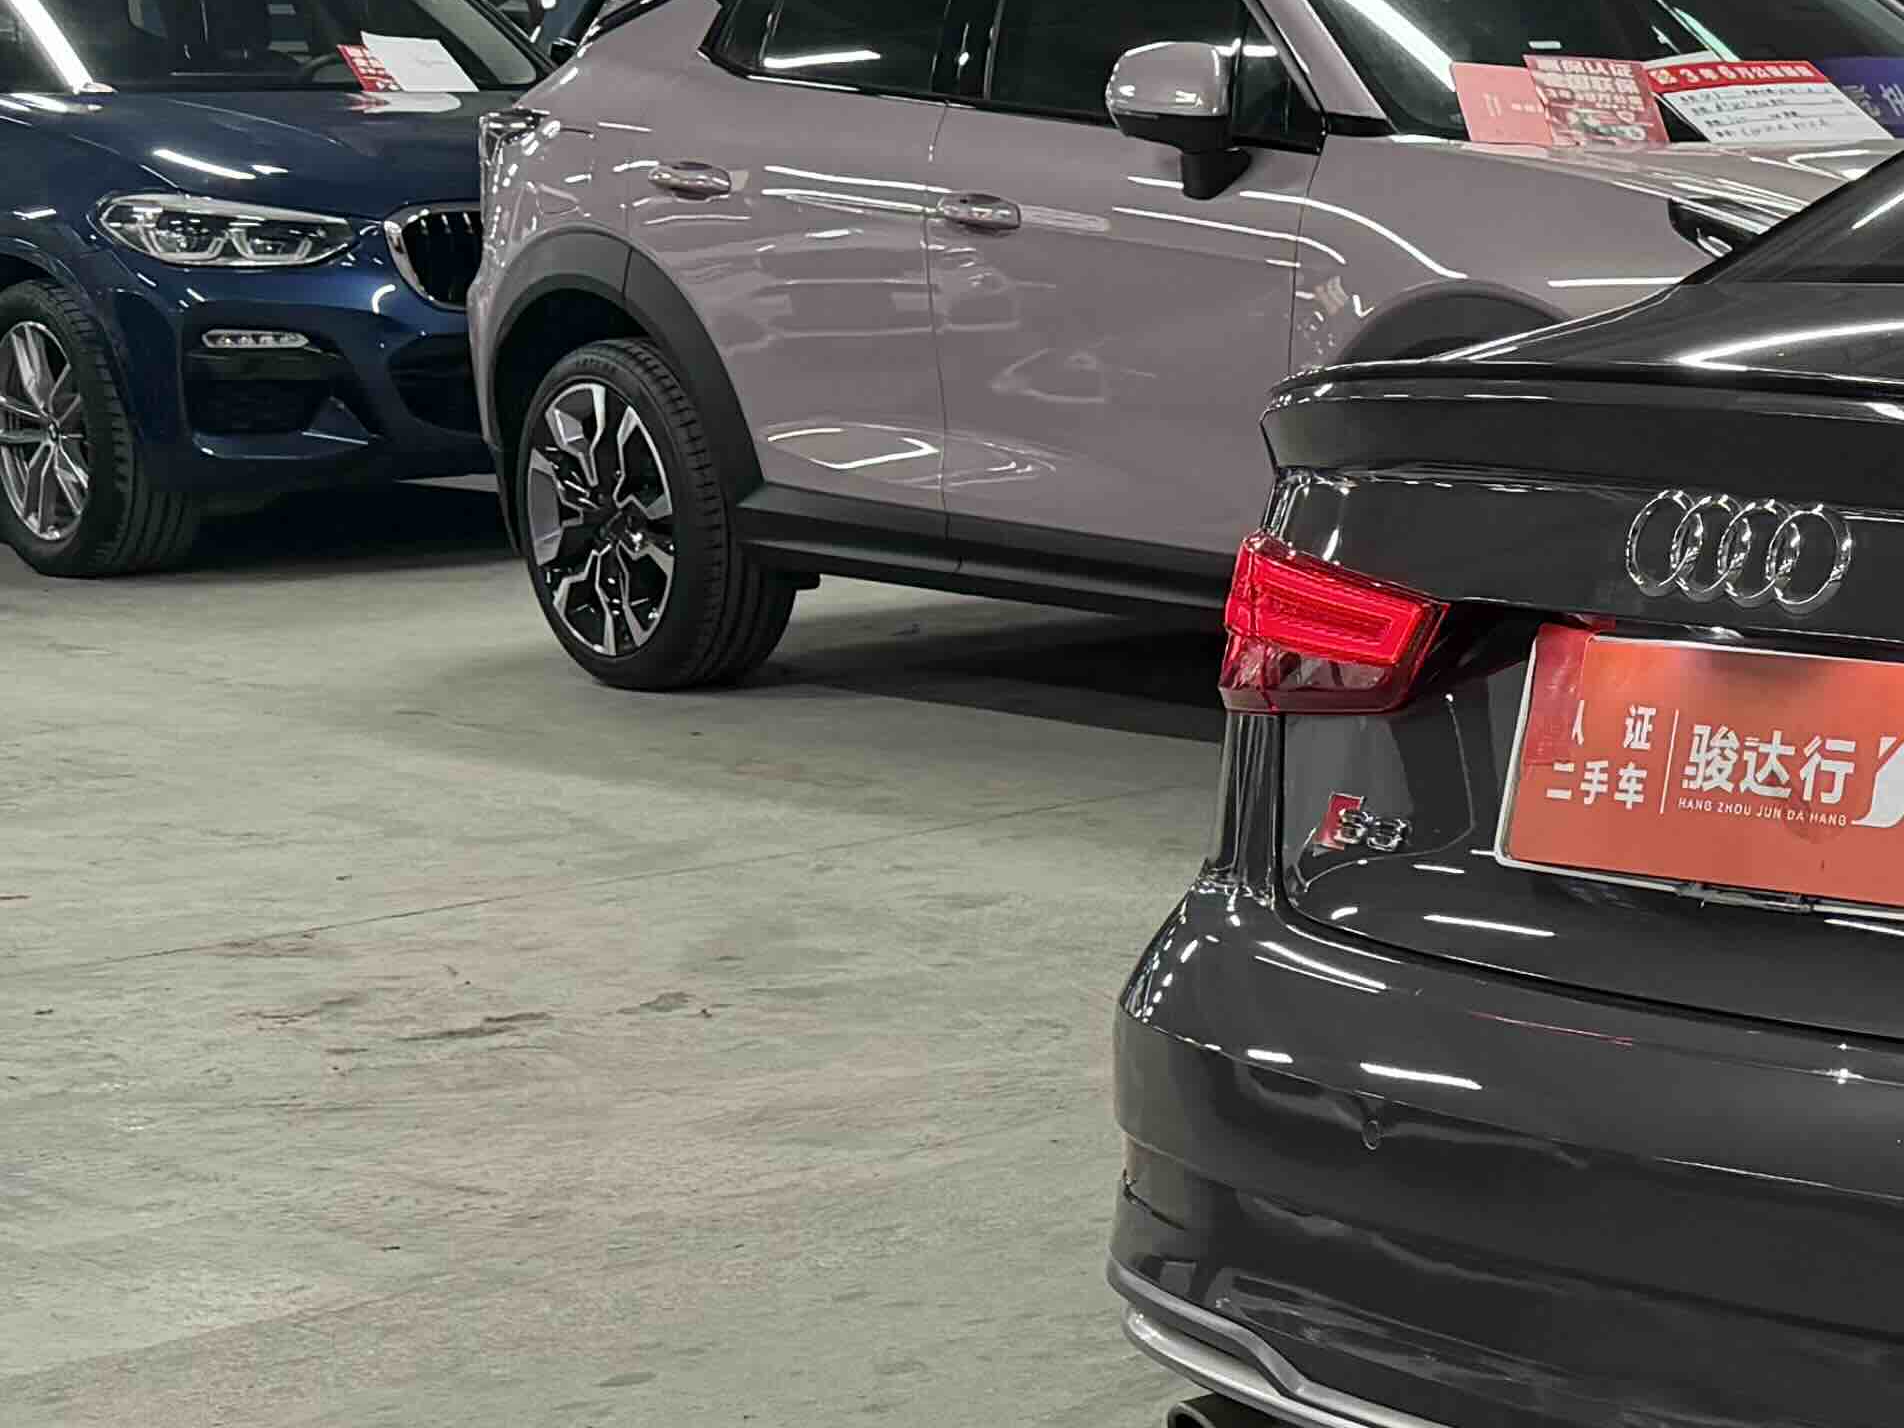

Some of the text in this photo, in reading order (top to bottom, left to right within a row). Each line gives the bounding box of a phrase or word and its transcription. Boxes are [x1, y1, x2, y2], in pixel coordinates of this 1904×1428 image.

[1545, 760, 1648, 810] 二手车
[1681, 724, 1857, 804] 骏达行
[1678, 796, 1848, 827] HANG ZHOU JUN DA HANG
